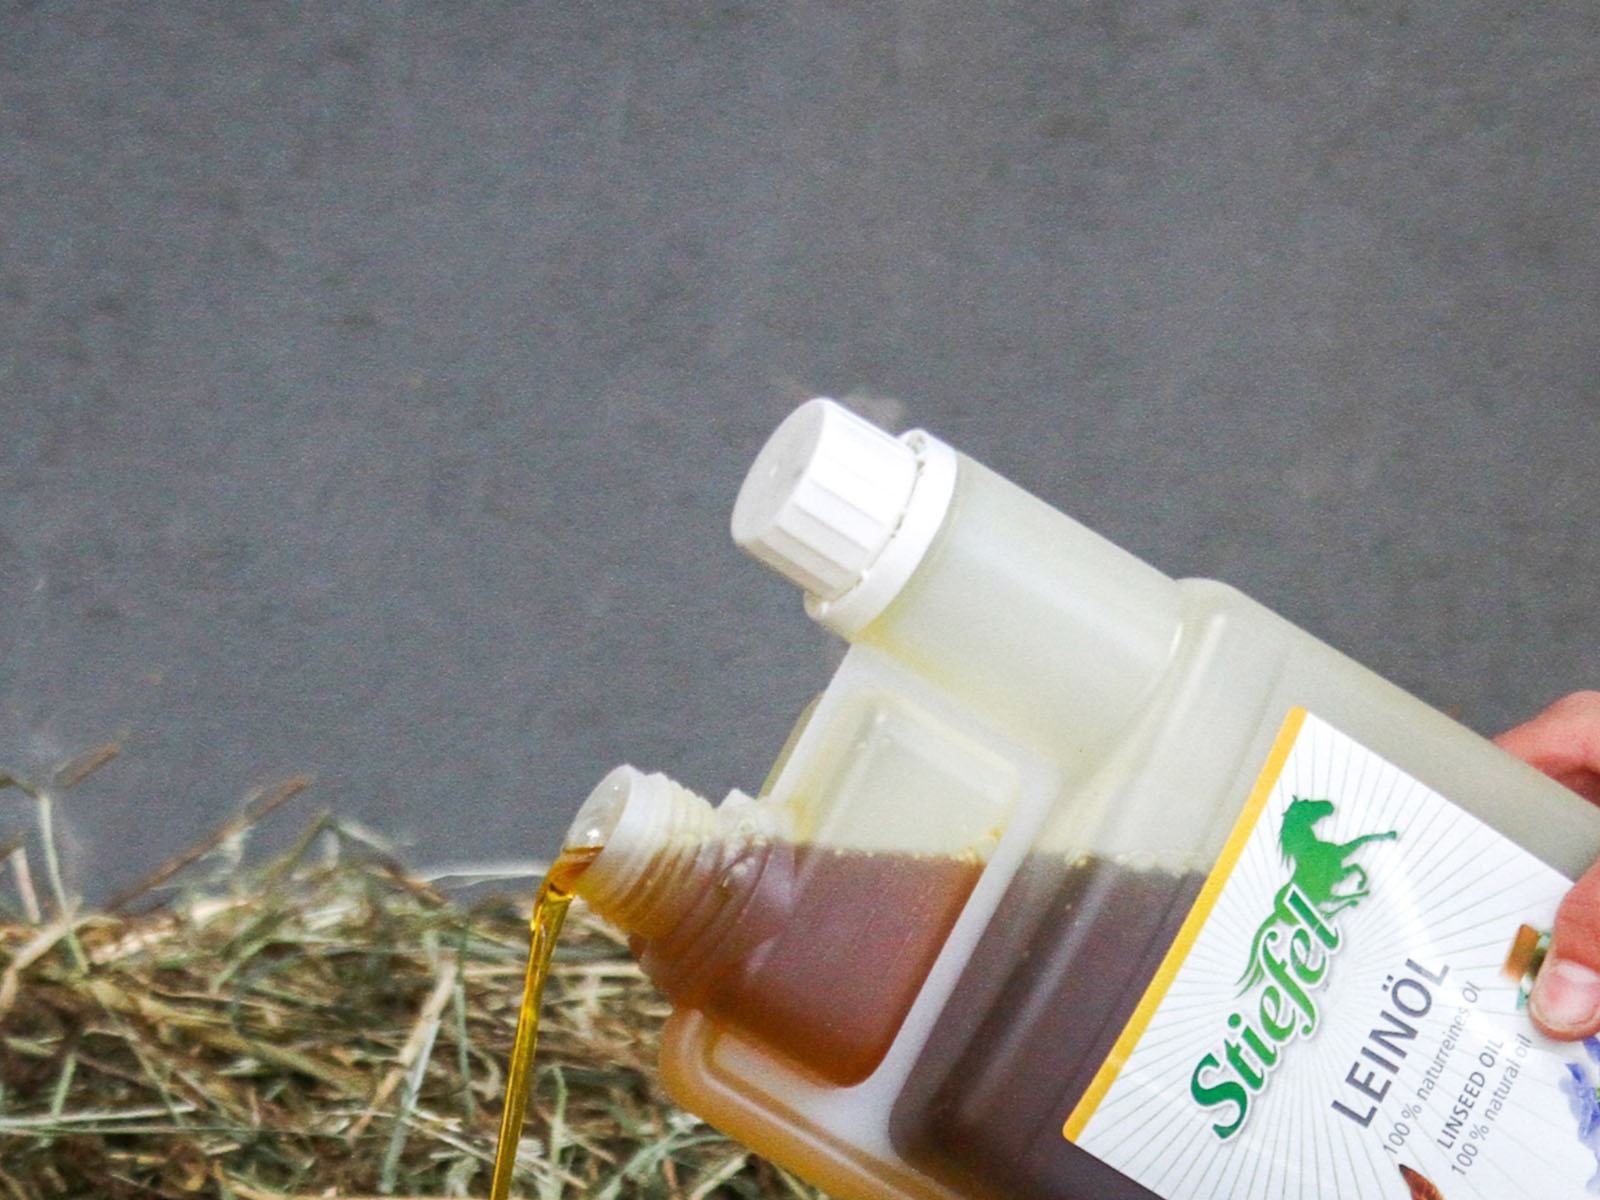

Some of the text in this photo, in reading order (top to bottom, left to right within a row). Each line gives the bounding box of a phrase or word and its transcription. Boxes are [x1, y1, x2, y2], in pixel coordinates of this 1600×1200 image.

[1190, 890, 1340, 1140] Stiefel
[1331, 958, 1450, 1129] LEINÖL
[1383, 1121, 1411, 1154] 100
[1401, 1103, 1423, 1121] %
[1416, 1005, 1470, 1102] naturreines
[1437, 1039, 1504, 1150] LINSEED OIL
[1451, 1032, 1533, 1176] 100 % natural oil
